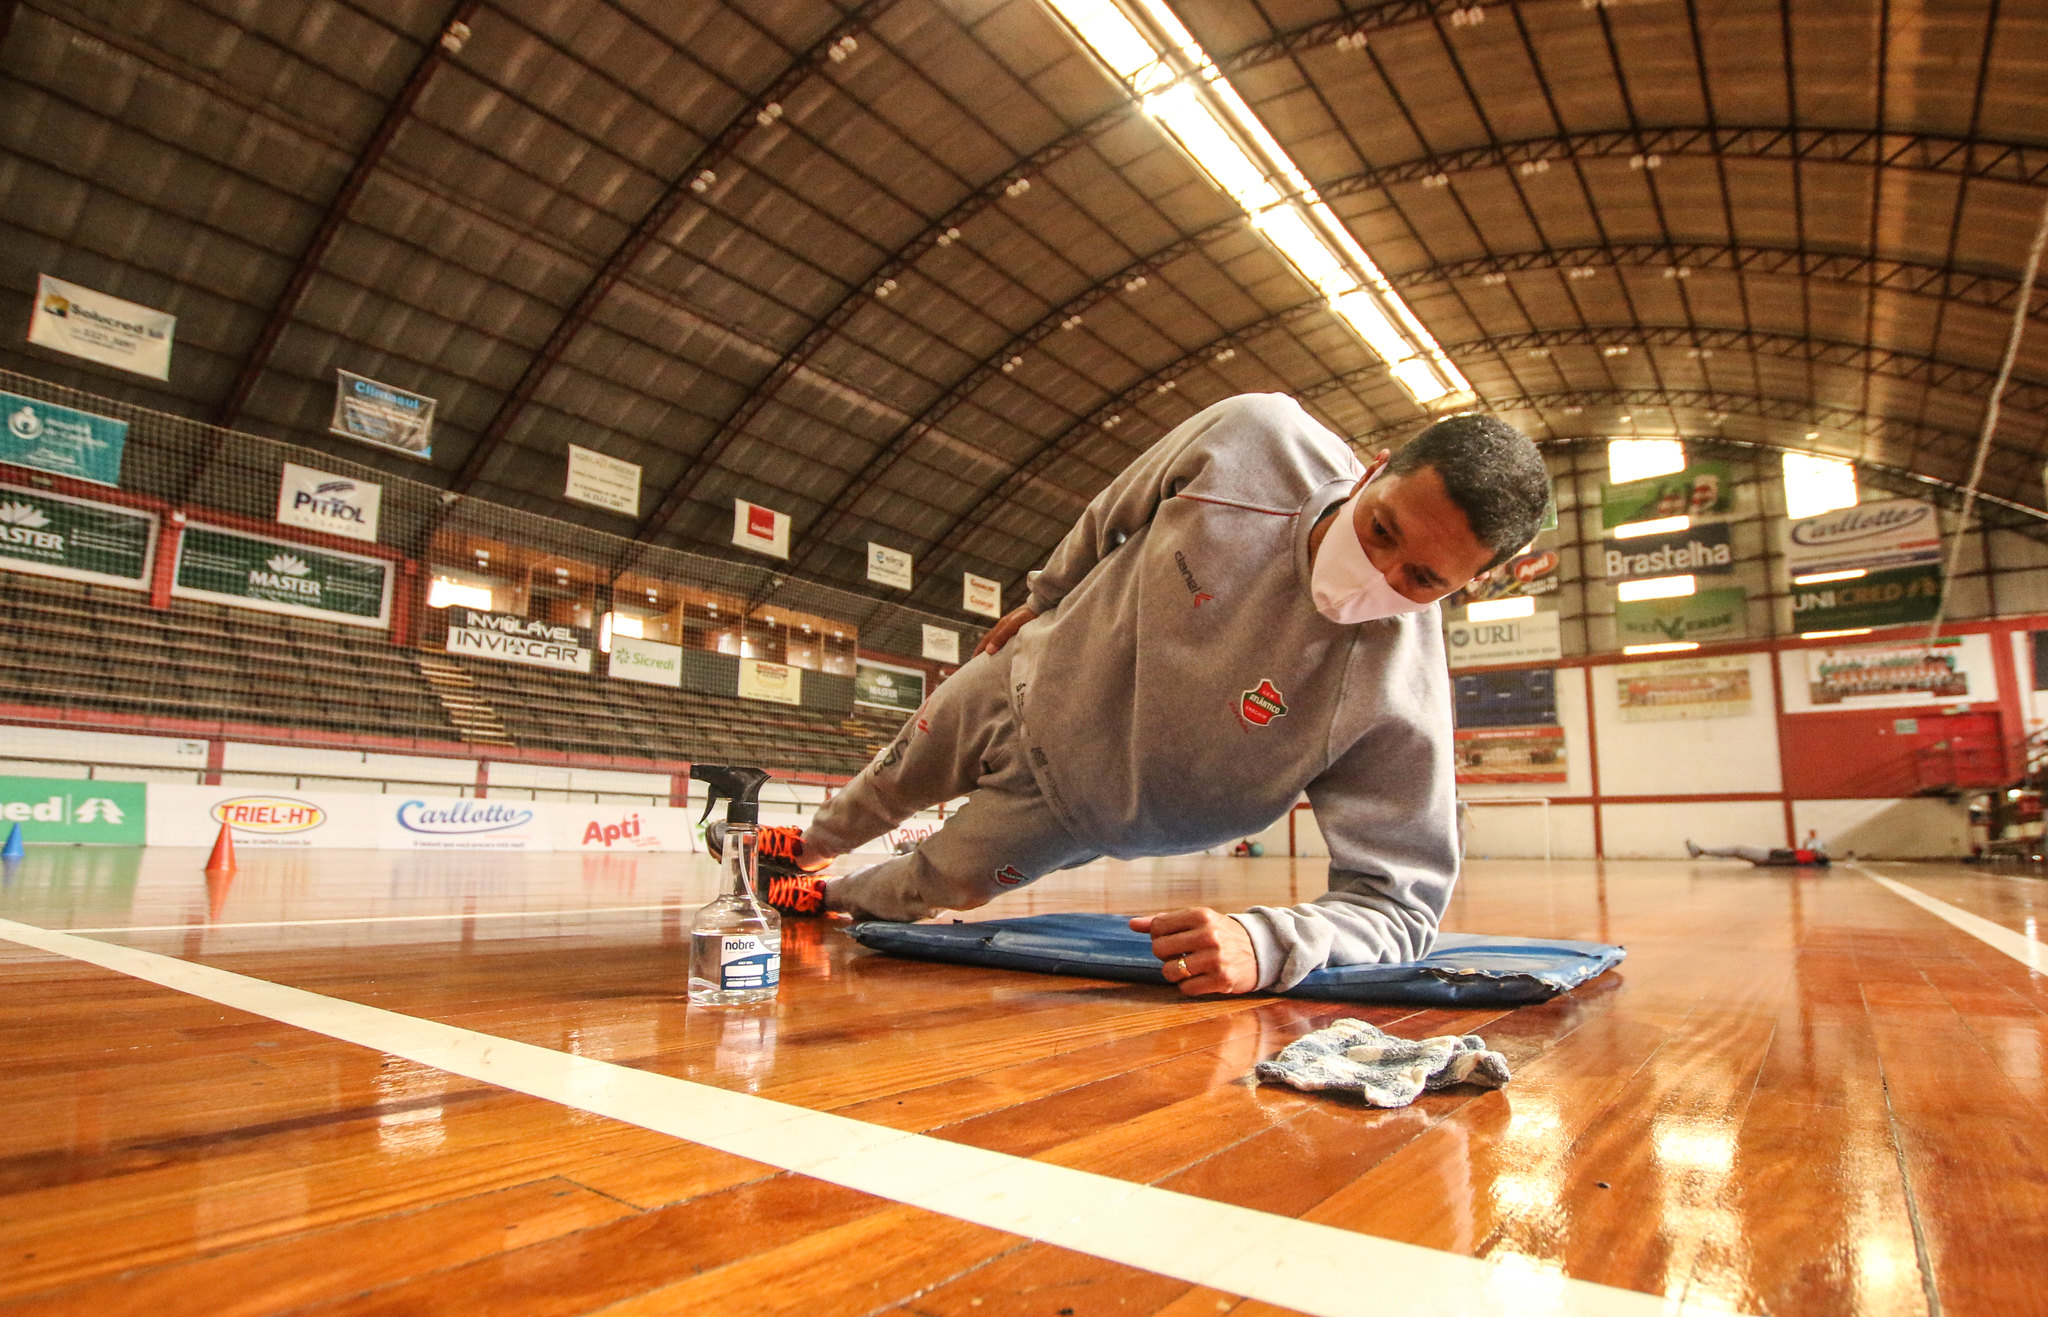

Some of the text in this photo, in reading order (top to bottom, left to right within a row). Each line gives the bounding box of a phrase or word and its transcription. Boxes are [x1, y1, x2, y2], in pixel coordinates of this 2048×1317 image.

[293, 490, 366, 524] PITTOL
[1790, 505, 1929, 546] Carllotto
[1605, 540, 1731, 577] Brastelha
[248, 570, 322, 597] MASTER
[1474, 623, 1514, 645] URI
[632, 652, 675, 671] Sicredi
[1248, 693, 1281, 715] ATLÂNTICO
[0, 796, 63, 822] ed
[221, 804, 318, 824] TRIEL-HT
[396, 800, 533, 834] Carllotto
[581, 812, 640, 847] Apti
[725, 939, 755, 951] nobre
